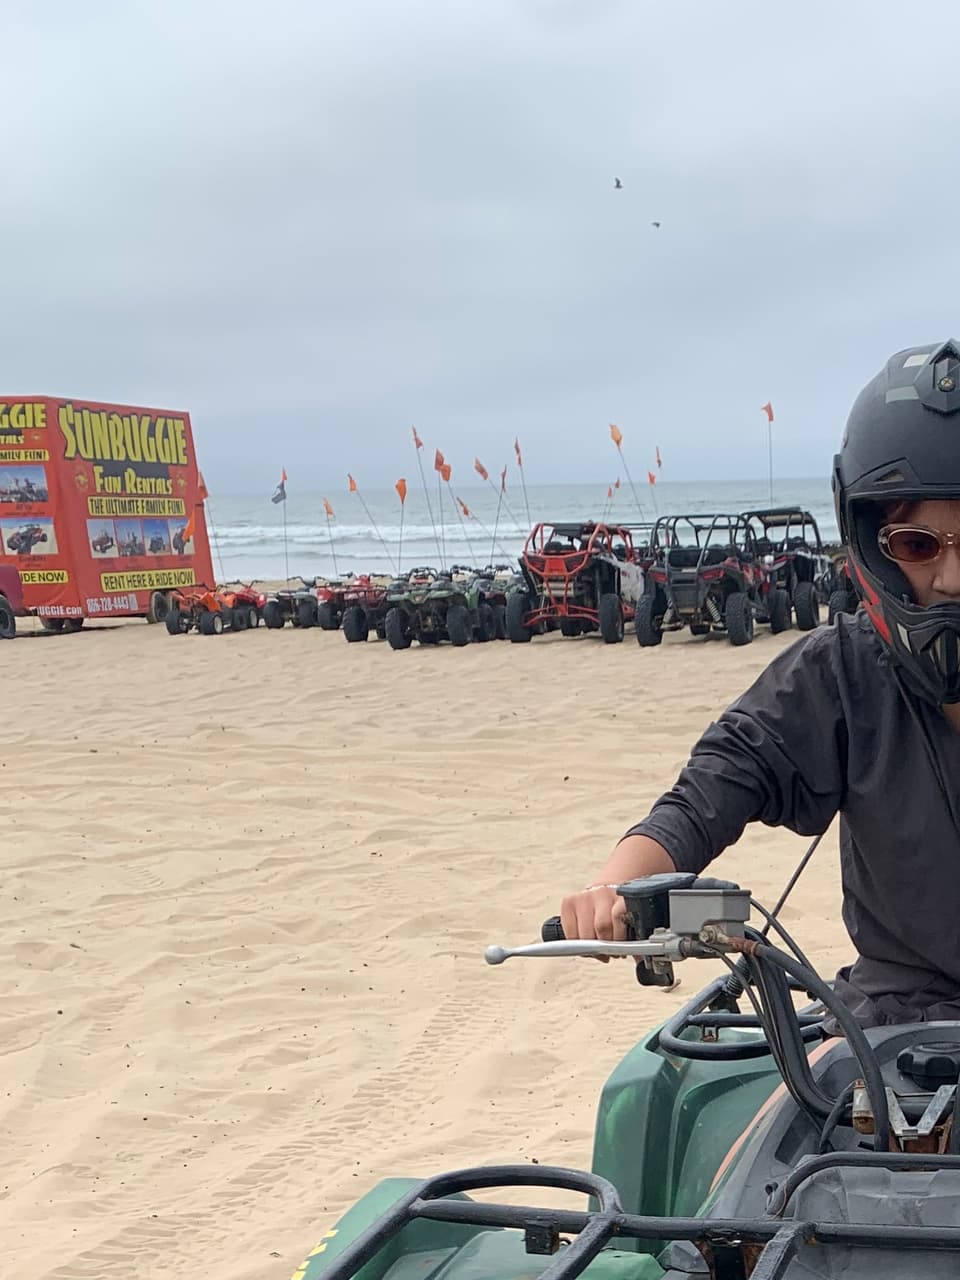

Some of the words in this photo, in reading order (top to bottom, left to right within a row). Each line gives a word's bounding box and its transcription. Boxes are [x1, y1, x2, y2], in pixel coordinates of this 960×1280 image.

[58, 402, 188, 464] SUNBUGGIE
[90, 499, 105, 514] THE
[105, 499, 140, 515] ULTIMATE
[141, 500, 165, 515] FAMILY
[38, 572, 65, 582] NOW
[104, 575, 126, 590] RENT
[127, 573, 147, 588] HERE
[155, 571, 173, 586] RIDE
[174, 570, 194, 586] NOW
